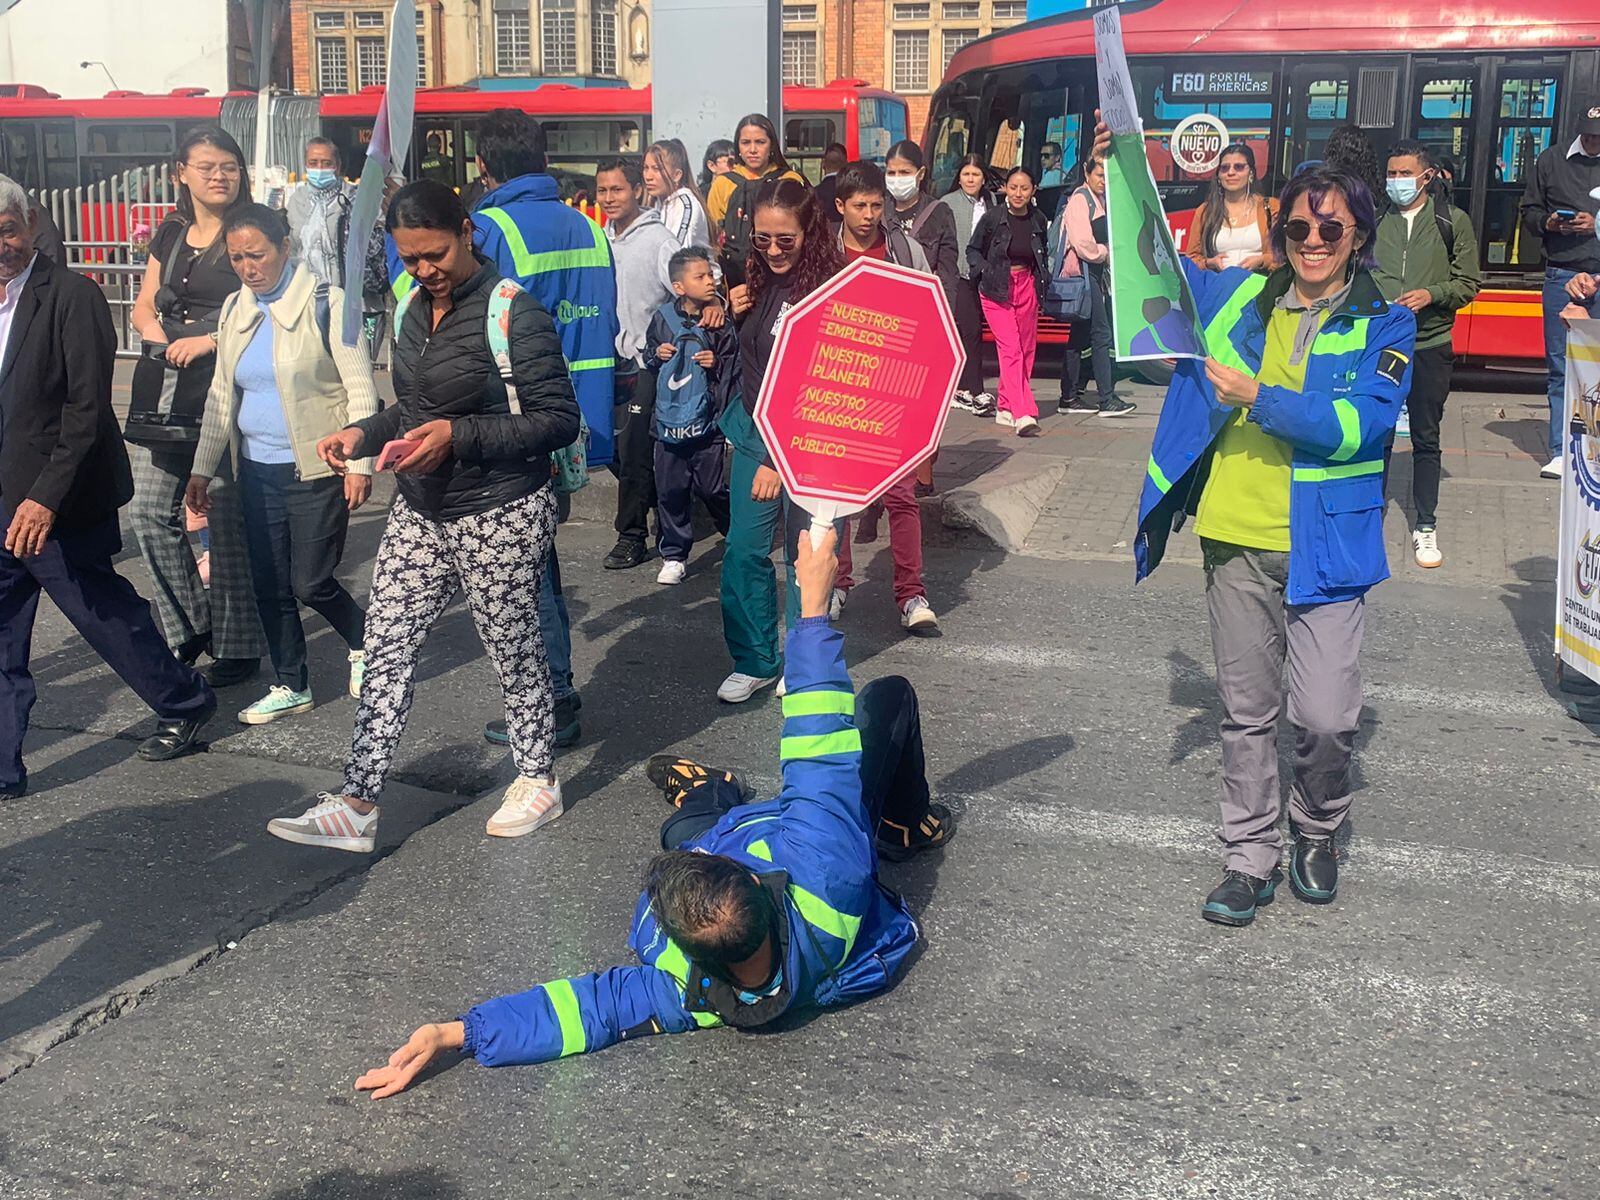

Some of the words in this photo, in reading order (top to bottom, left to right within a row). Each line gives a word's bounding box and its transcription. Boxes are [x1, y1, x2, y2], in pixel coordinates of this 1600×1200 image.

[1172, 73, 1205, 93] F60
[1208, 82, 1268, 92] AMERICAS
[1209, 72, 1253, 82] PORTAL
[1192, 124, 1210, 135] SOY
[1180, 135, 1219, 151] NUEVO
[831, 303, 900, 332] NUESTROS
[825, 322, 886, 348] EMPLEOS
[818, 344, 880, 370] NUESTRO
[812, 364, 871, 389] PLANETA
[805, 387, 867, 411] NUESTRO
[664, 424, 702, 439] NIKE
[800, 407, 885, 436] TRANSPORTE
[1564, 597, 1590, 618] CENTRAL
[1564, 612, 1572, 625] DE
